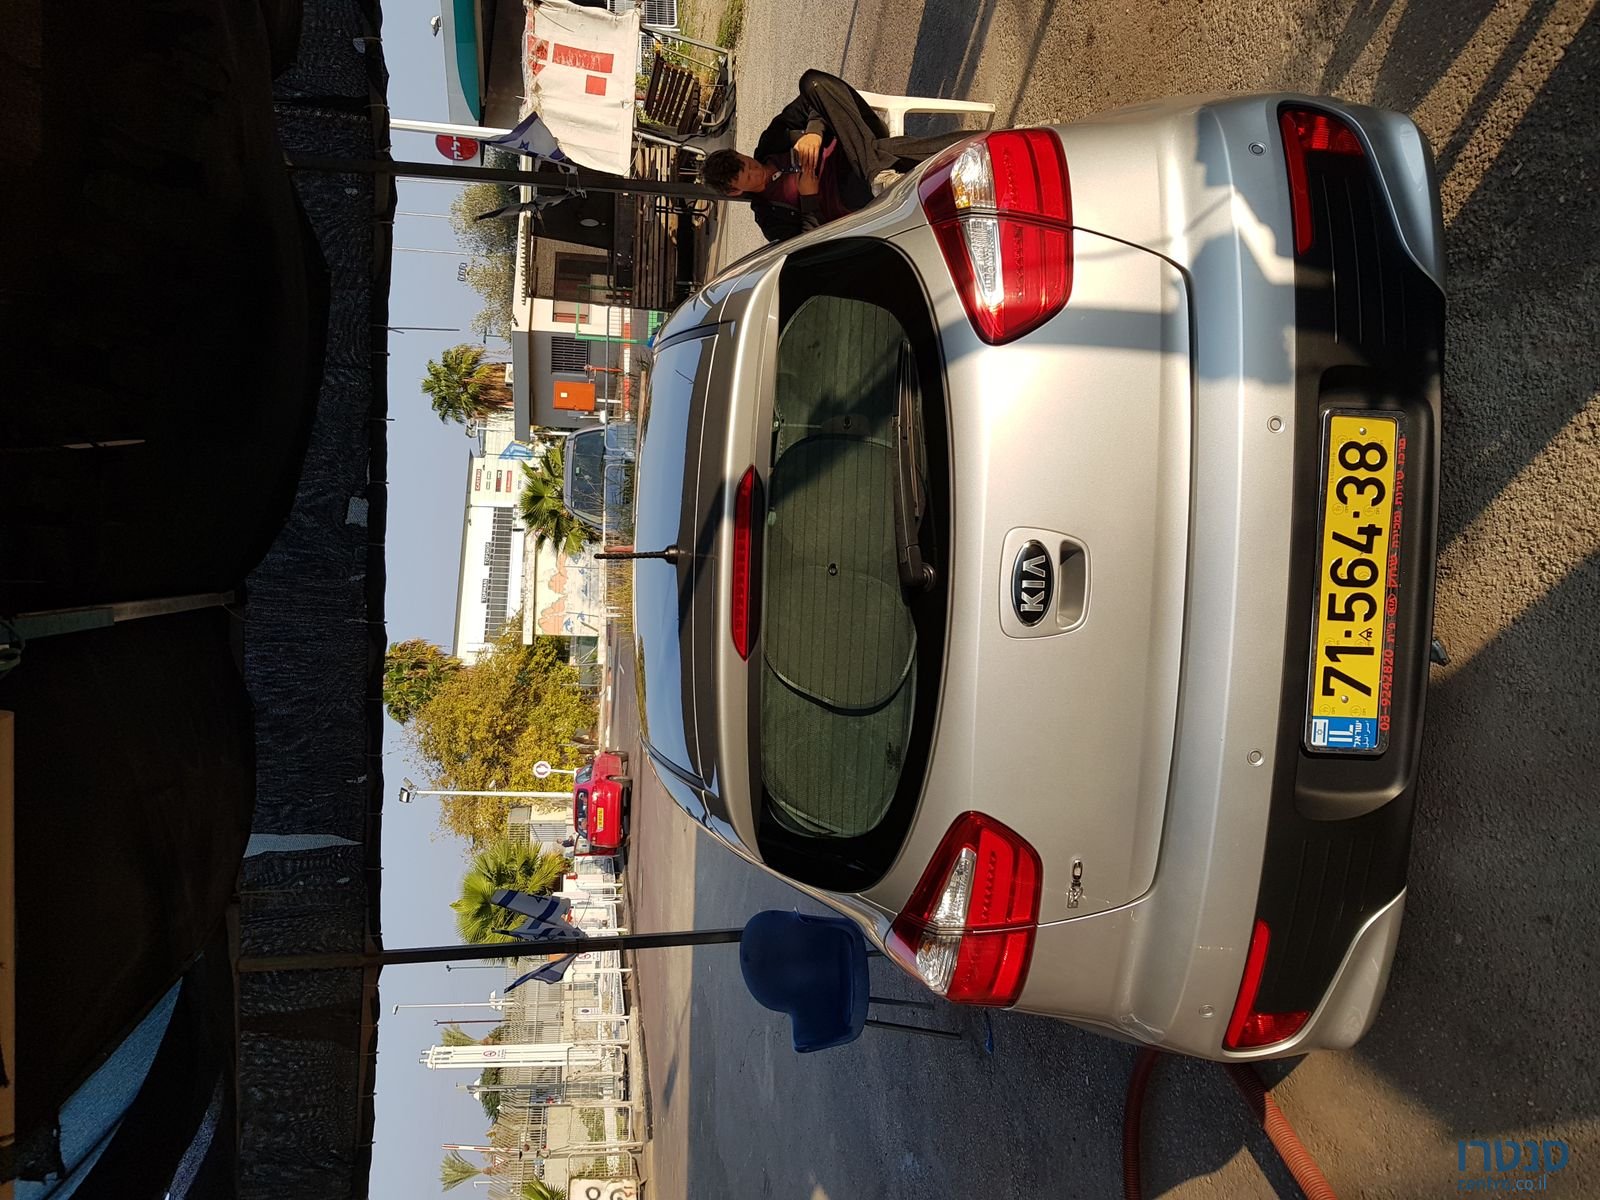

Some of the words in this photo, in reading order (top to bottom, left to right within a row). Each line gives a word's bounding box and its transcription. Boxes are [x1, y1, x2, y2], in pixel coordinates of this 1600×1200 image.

[1398, 437, 1406, 465] מרכז
[1394, 470, 1405, 507] שירות
[1391, 511, 1402, 549] ומכירה
[1020, 555, 1046, 612] KIA
[1380, 649, 1395, 732] 03-9242820
[1328, 724, 1354, 743] IL
[1353, 720, 1363, 748] ישראל
